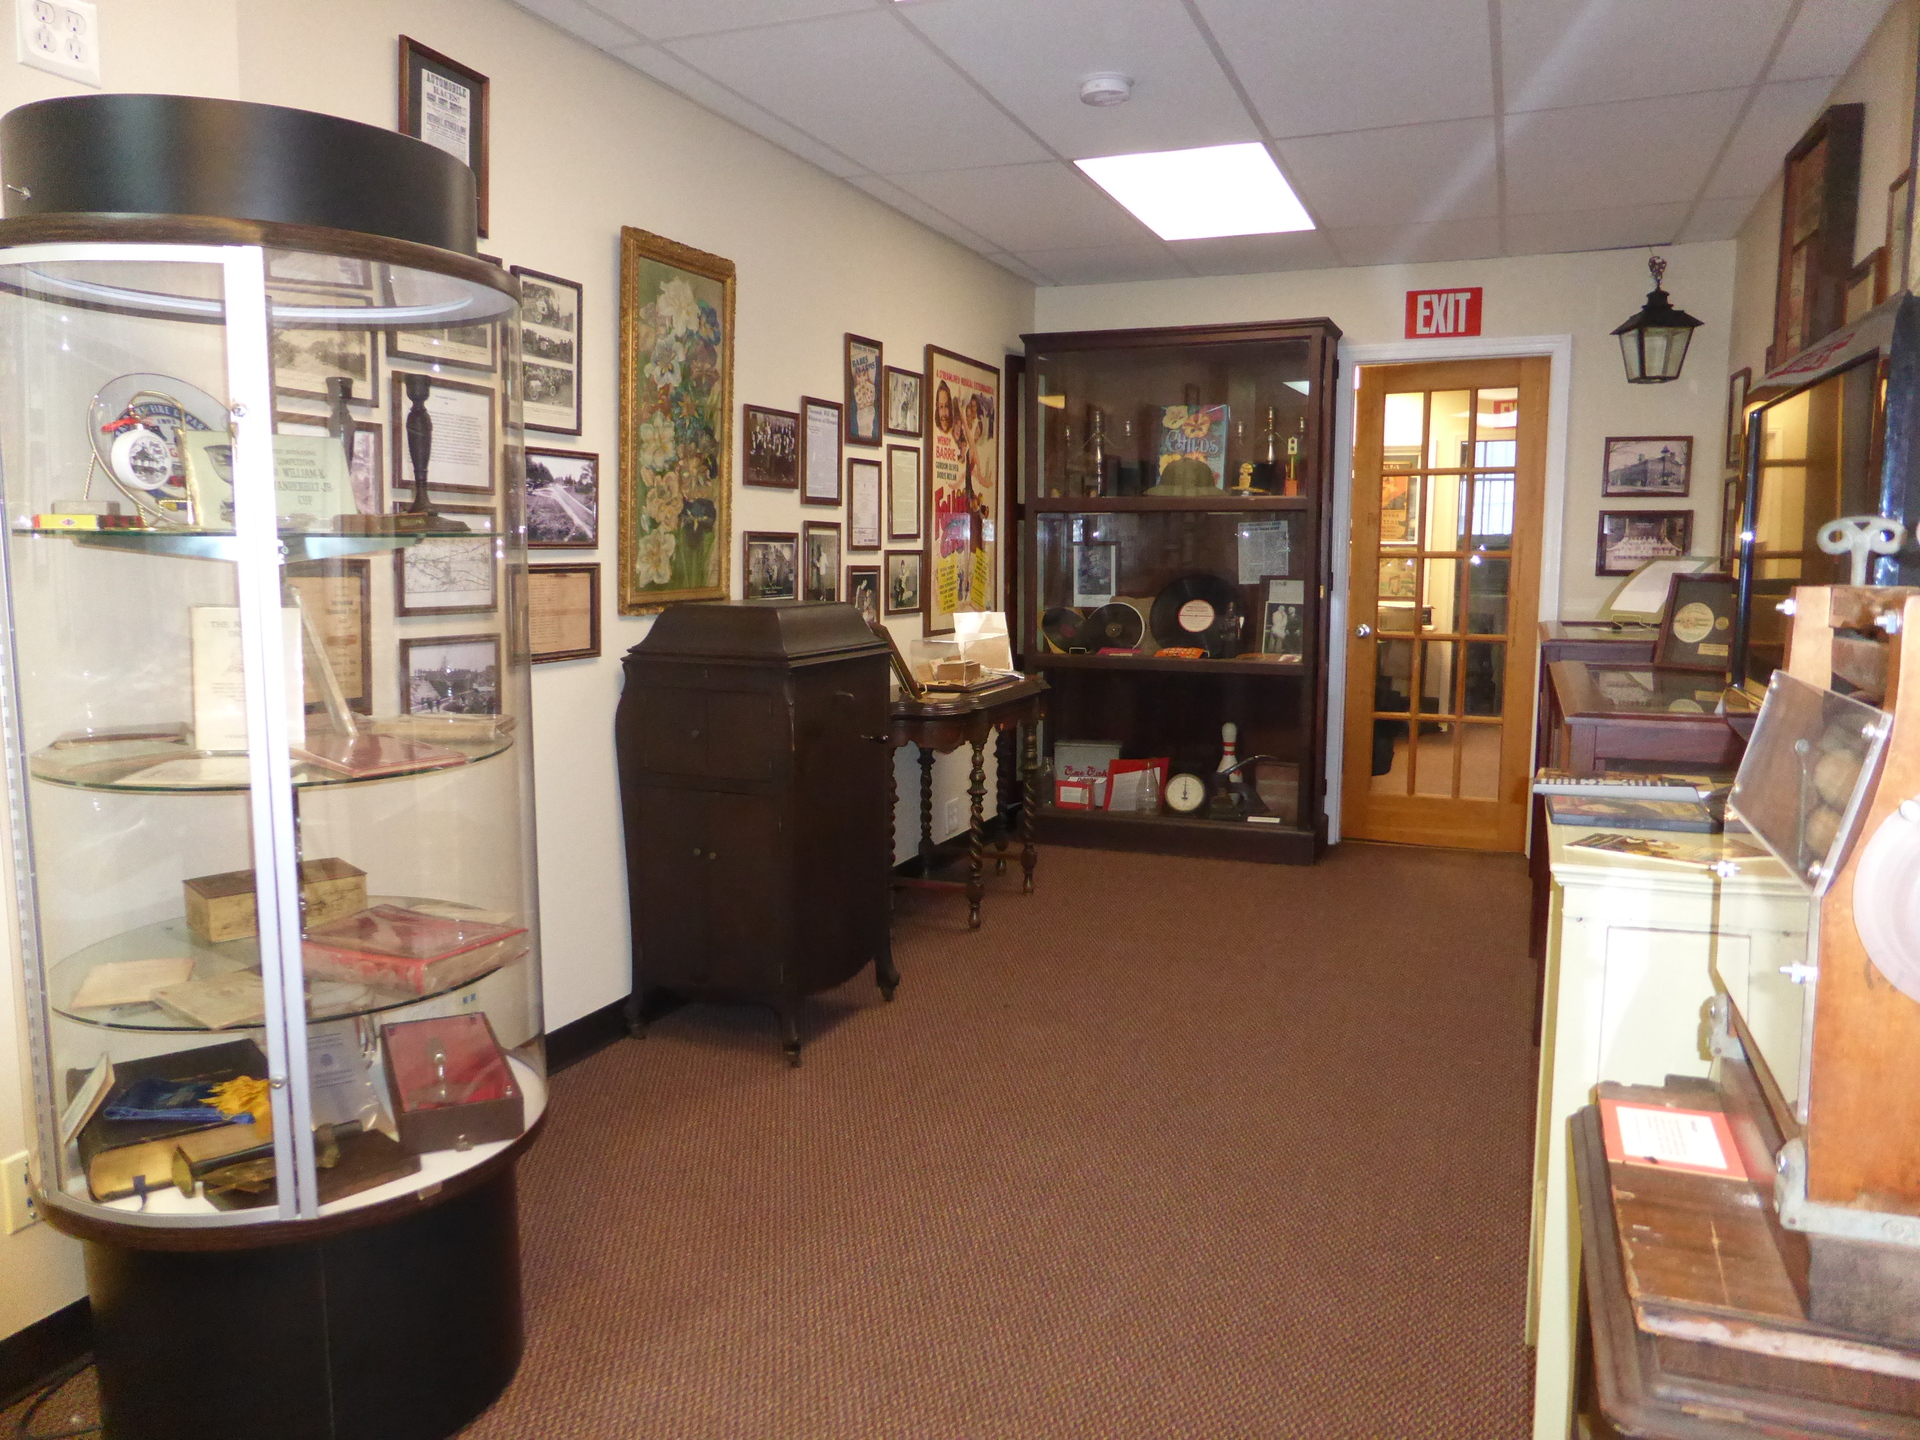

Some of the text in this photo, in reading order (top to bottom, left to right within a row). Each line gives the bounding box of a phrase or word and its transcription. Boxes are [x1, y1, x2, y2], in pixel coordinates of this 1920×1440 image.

[1416, 292, 1471, 335] EXIT
[937, 435, 952, 446] WENDY
[1166, 430, 1219, 454] CHILDS
[935, 446, 956, 462] BARRIE
[275, 481, 320, 492] ANDERBILT
